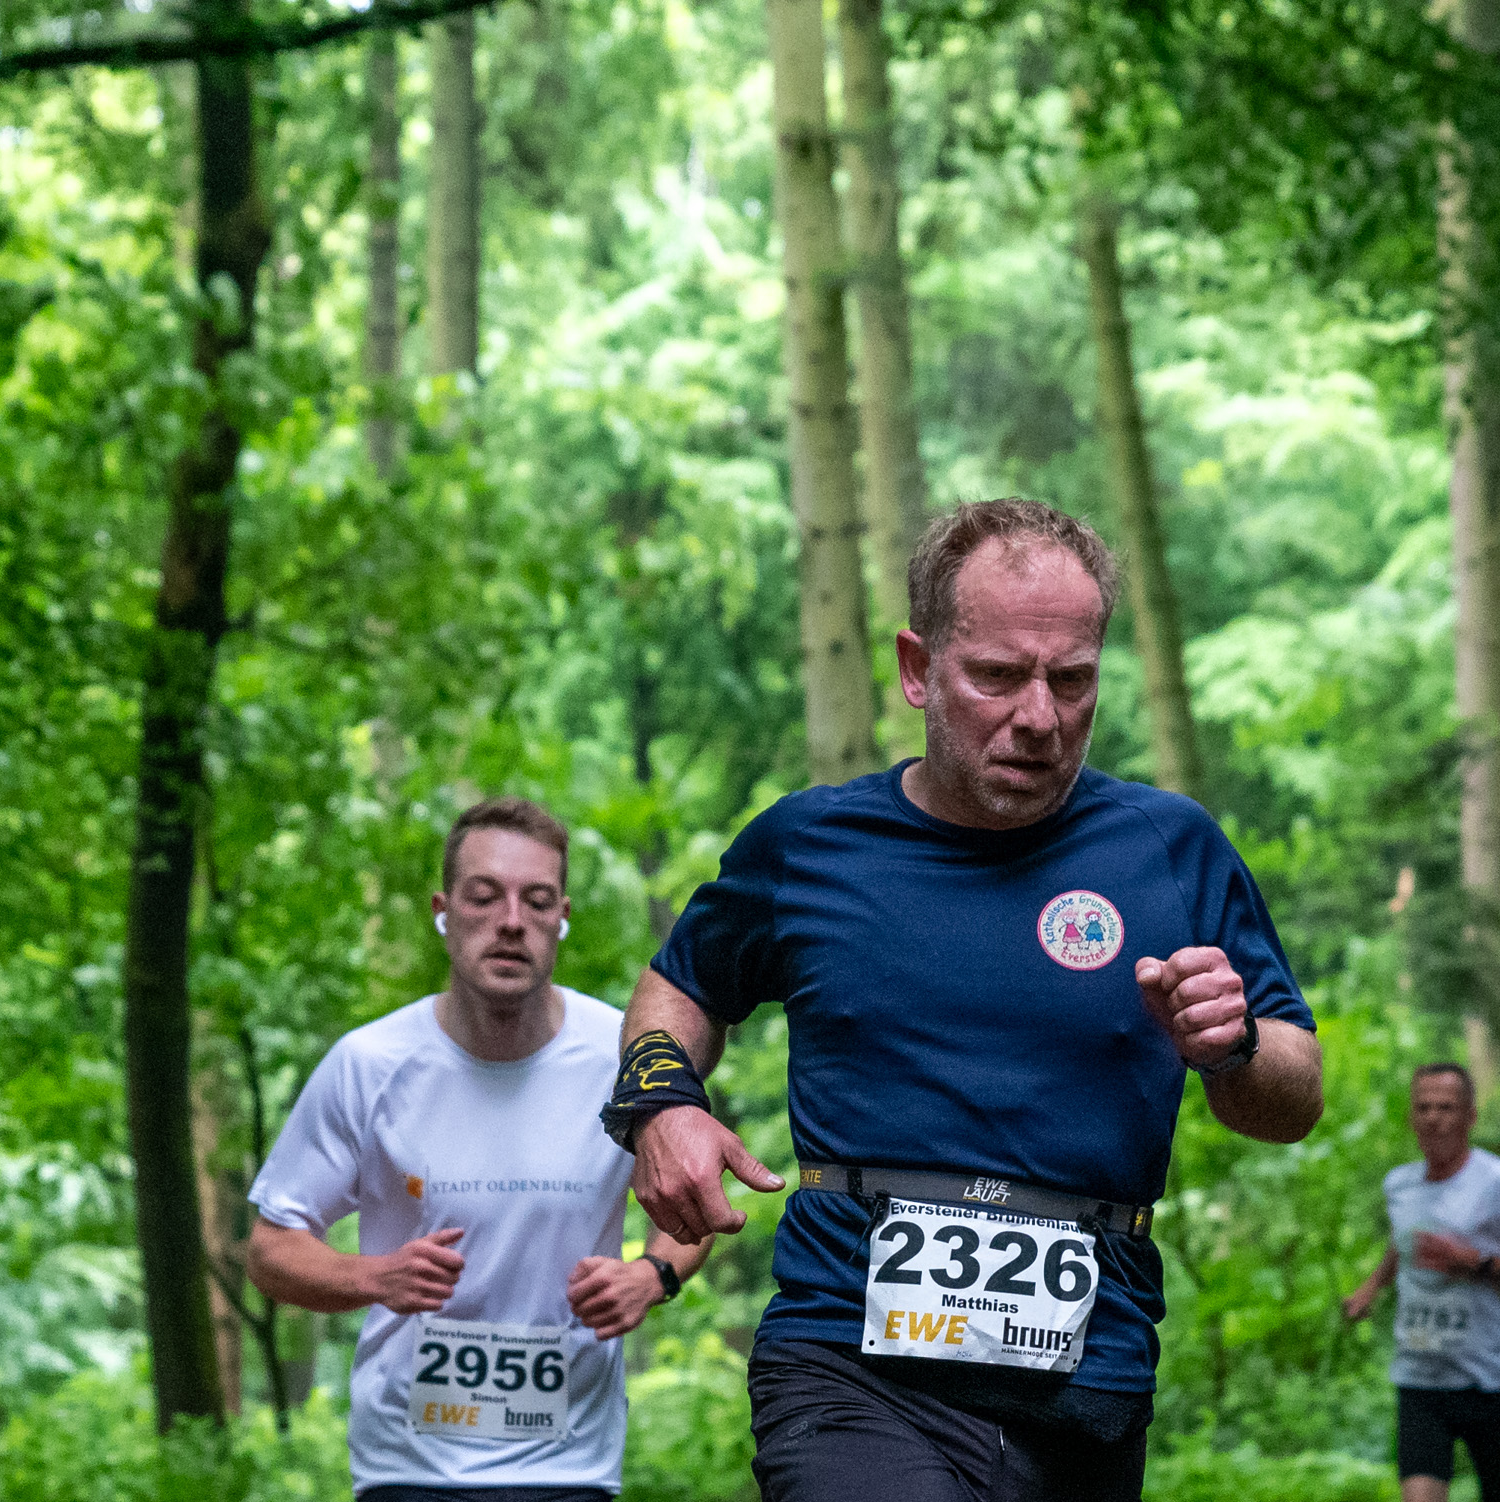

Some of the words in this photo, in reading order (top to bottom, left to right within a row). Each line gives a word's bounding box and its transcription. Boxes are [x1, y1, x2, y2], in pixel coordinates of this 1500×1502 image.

[1079, 895, 1119, 942] Grundschule
[1061, 948, 1108, 963] Eversten
[431, 1180, 480, 1193] STADT
[486, 1179, 584, 1194] OLDENBURG
[974, 1176, 1010, 1192] EWE
[963, 1186, 1011, 1202] LÄUFT
[873, 1221, 1092, 1302] 2326
[941, 1294, 1019, 1314] Matthias
[424, 1327, 488, 1342] Everstener
[491, 1333, 561, 1345] Brunnenlauf
[884, 1310, 968, 1345] EWE
[1002, 1317, 1073, 1352] bruns
[415, 1341, 565, 1392] 2956
[470, 1392, 507, 1404] Simon
[422, 1401, 481, 1426] EWE
[504, 1406, 553, 1427] bruns
